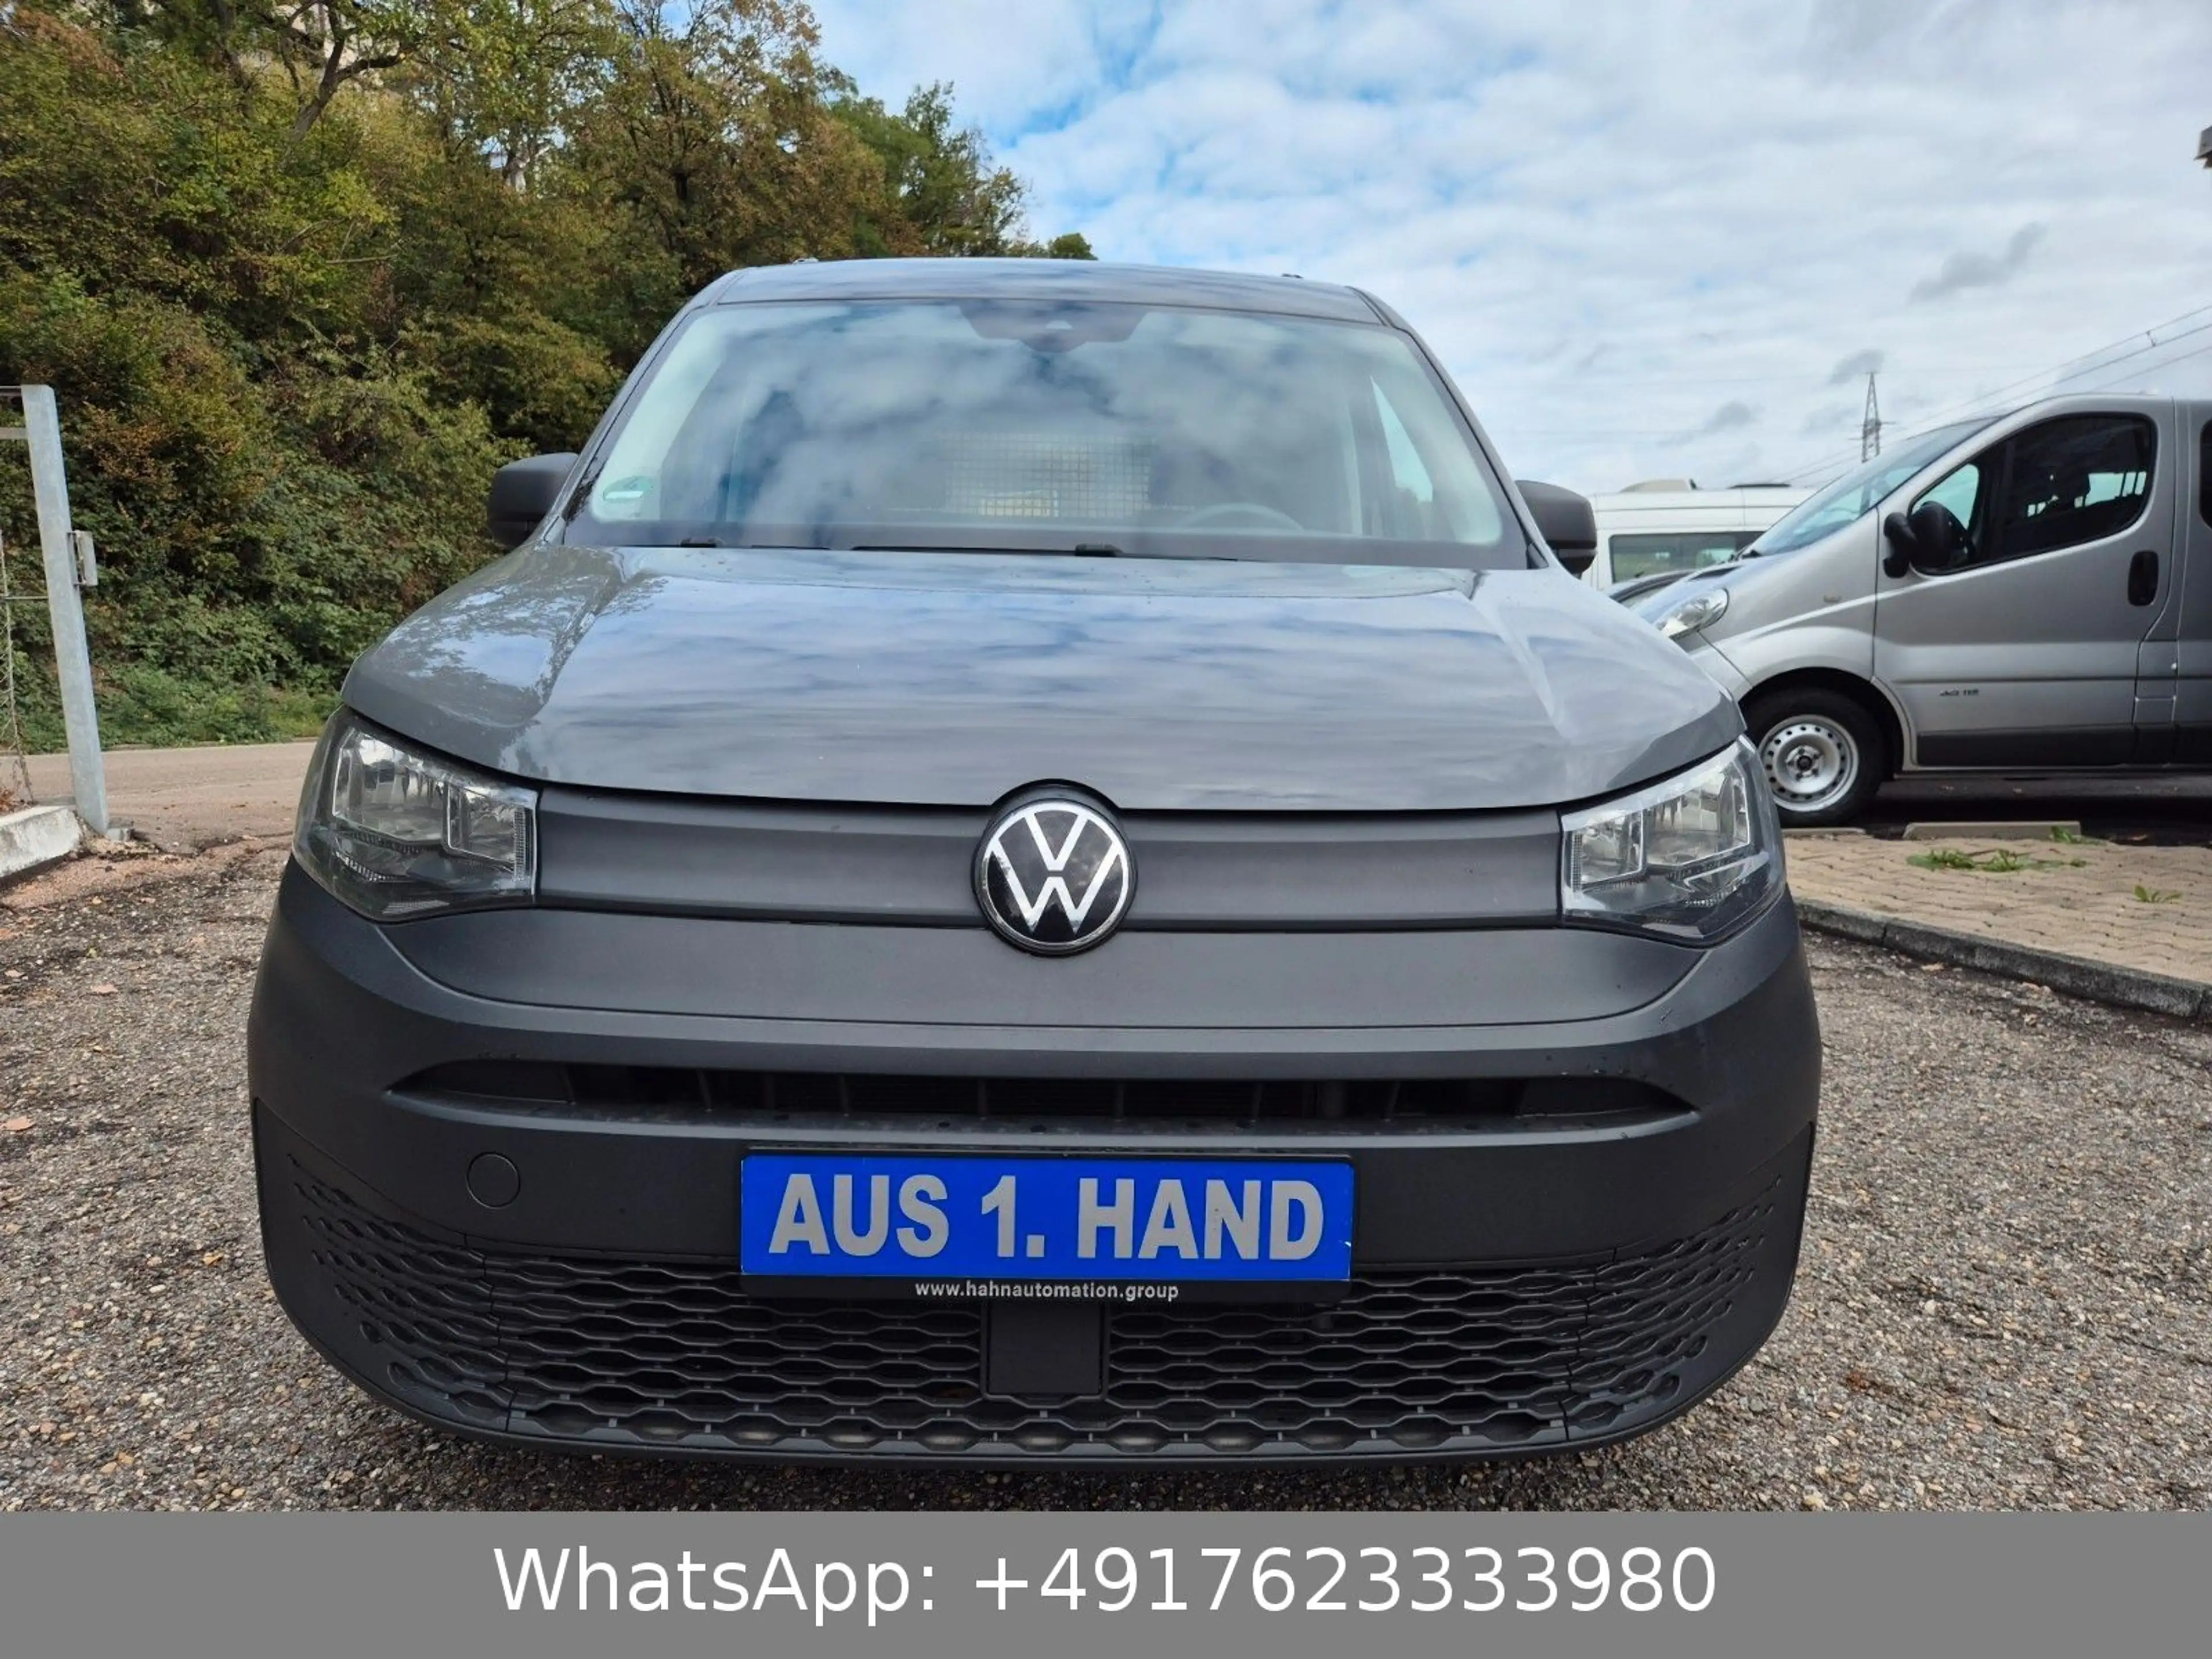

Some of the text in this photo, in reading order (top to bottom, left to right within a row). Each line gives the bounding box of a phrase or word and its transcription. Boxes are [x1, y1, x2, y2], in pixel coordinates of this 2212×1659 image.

[984, 802, 1127, 942] VW
[769, 1174, 1324, 1260] AUS 1. HAND
[915, 1280, 1179, 1302] www.hahnautomation.group
